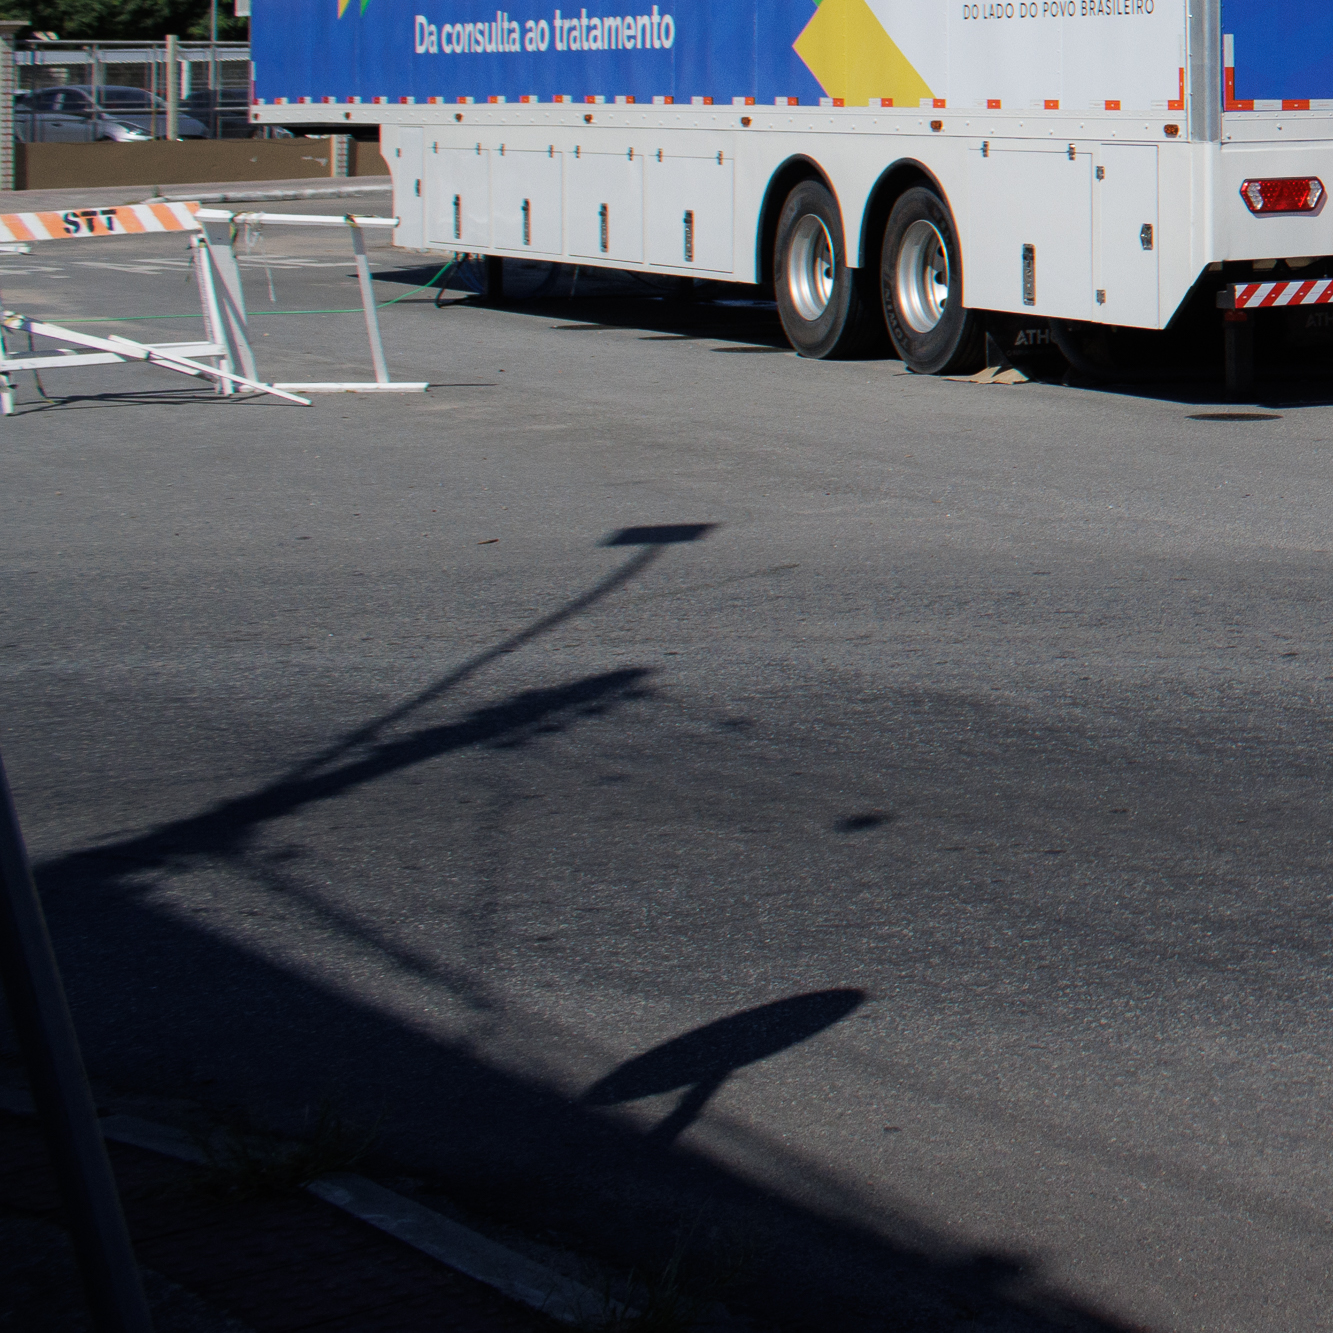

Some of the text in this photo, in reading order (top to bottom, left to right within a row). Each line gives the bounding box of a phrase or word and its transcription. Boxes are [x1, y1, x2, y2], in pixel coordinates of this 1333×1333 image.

[963, 5, 980, 20] DO
[983, 2, 1014, 19] LADO
[1019, 2, 1038, 18] DO
[1043, 0, 1075, 17] POVO
[415, 5, 676, 54] Da consulta ao tratamento
[62, 209, 117, 234] STT
[1014, 328, 1050, 345] ATH
